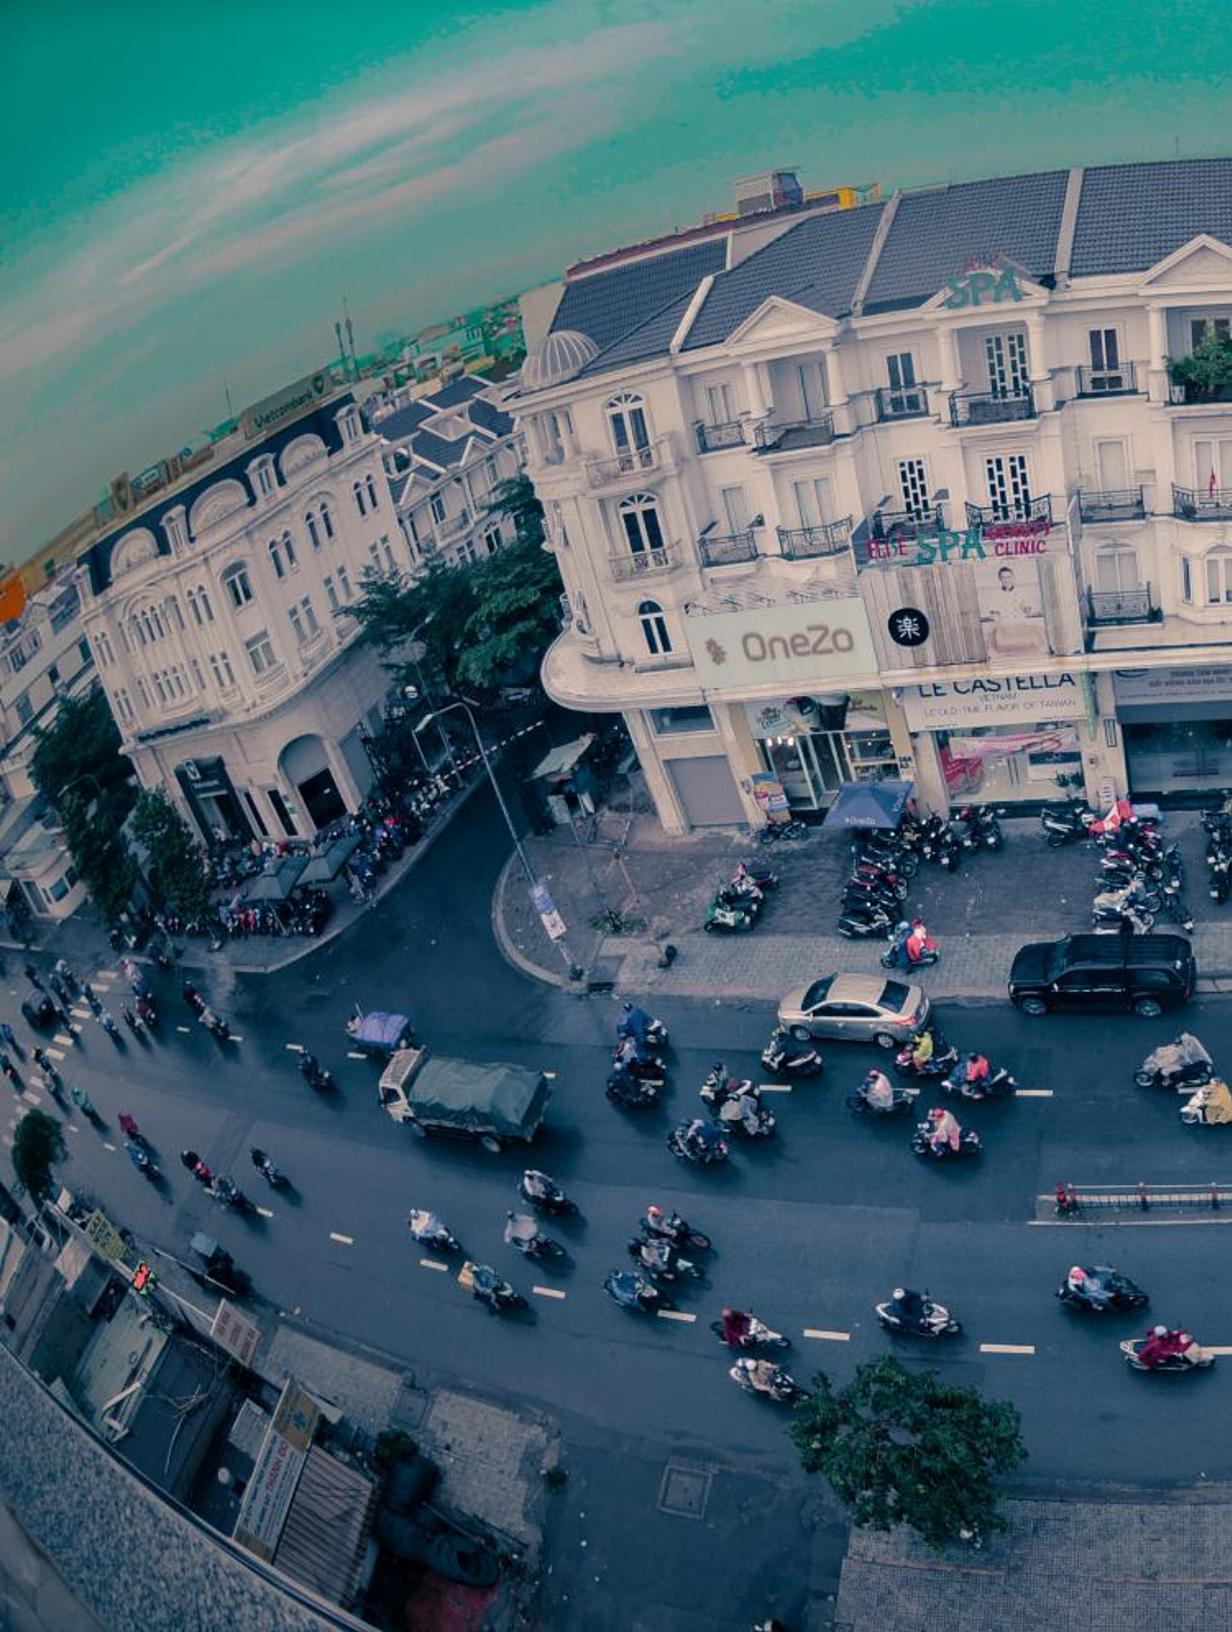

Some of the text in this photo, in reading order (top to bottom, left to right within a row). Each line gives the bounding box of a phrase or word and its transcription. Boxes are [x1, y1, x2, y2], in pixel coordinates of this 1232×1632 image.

[946, 267, 1023, 309] SPA
[916, 528, 986, 564] SPA
[995, 539, 1047, 557] CLINIC
[742, 625, 854, 662] OneZo
[919, 672, 1076, 698] LE CASTELLA
